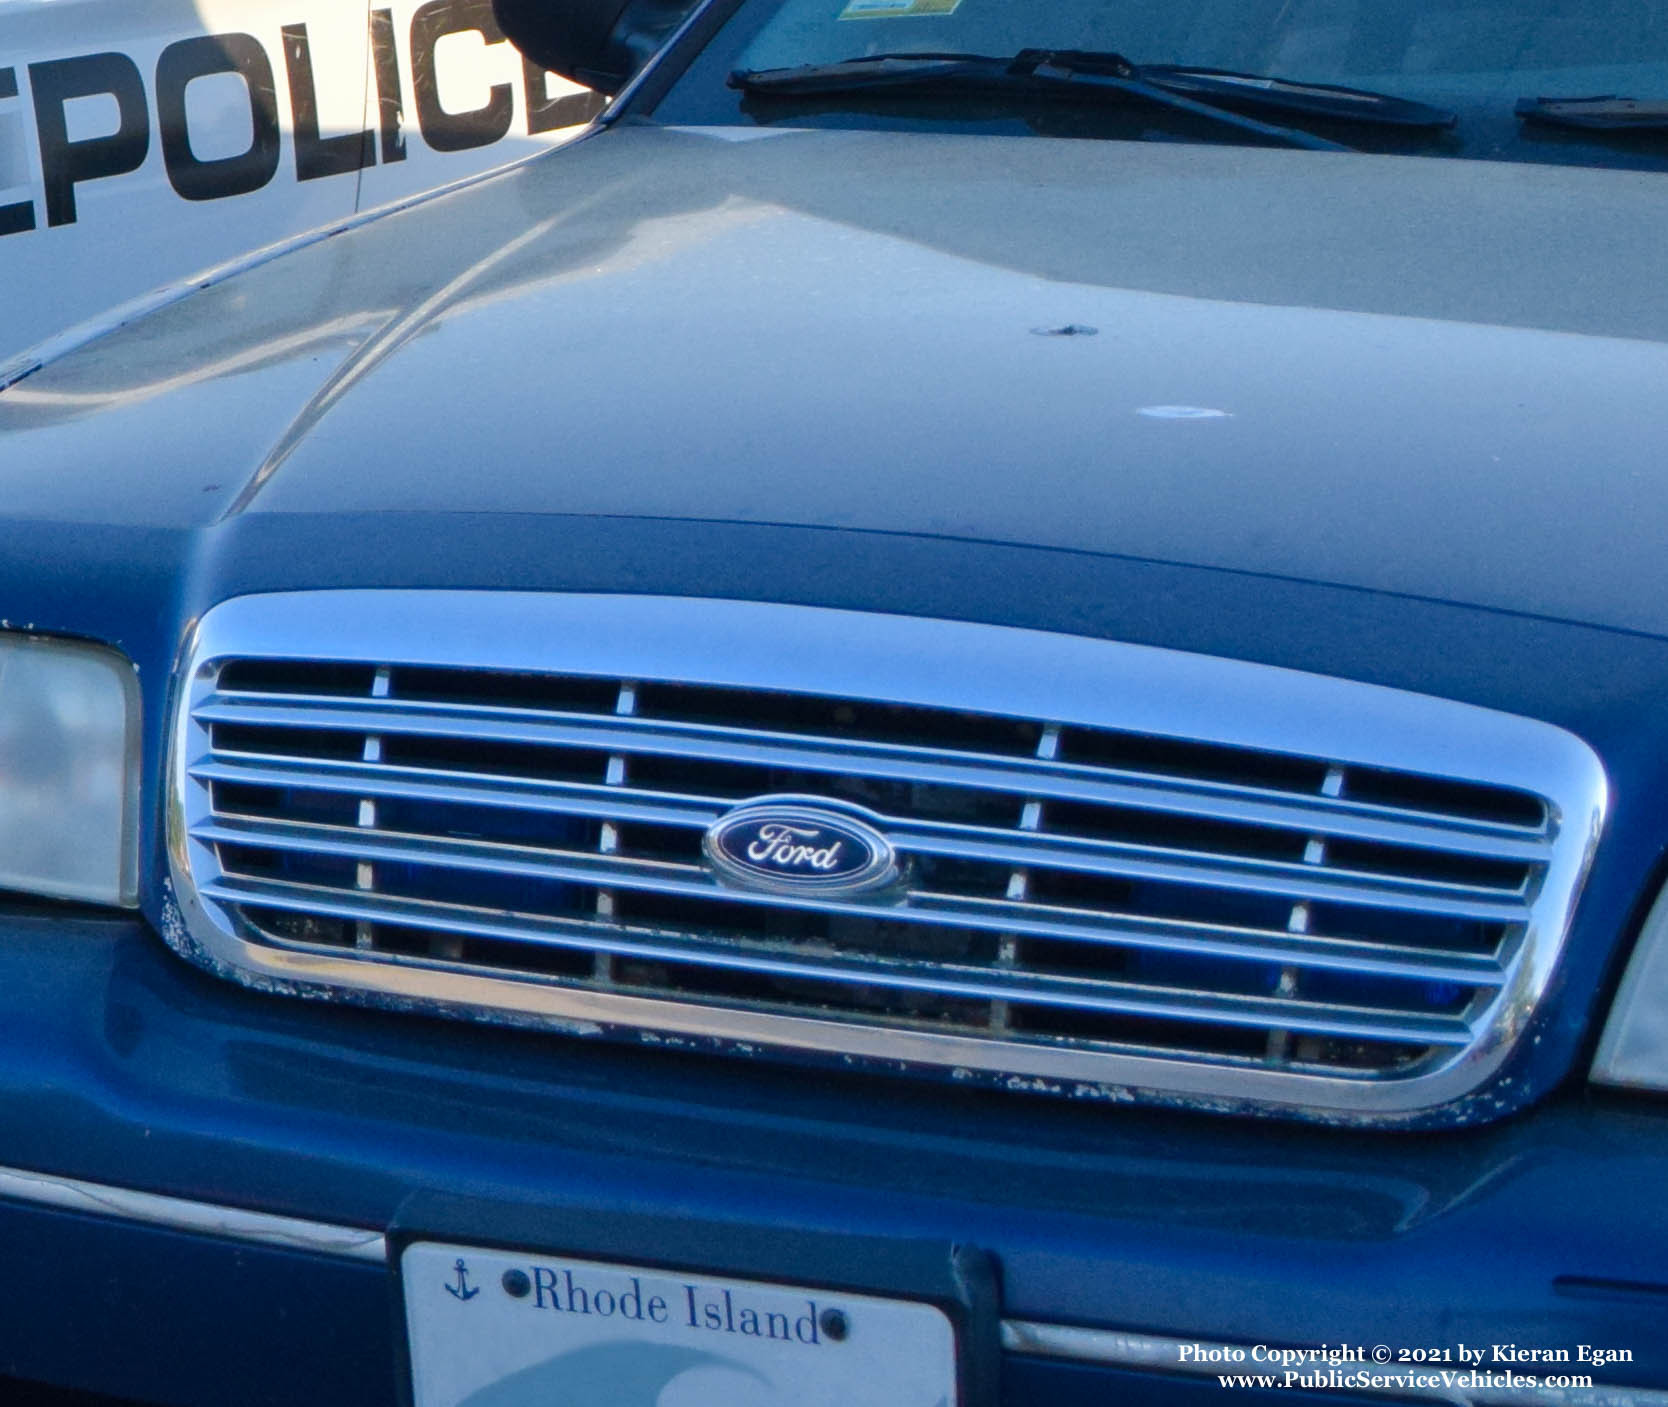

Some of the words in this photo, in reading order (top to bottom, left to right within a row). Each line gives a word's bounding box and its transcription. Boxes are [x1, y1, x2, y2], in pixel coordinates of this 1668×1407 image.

[747, 823, 841, 870] Ford
[530, 1265, 669, 1324] Rhode
[682, 1284, 822, 1346] Island
